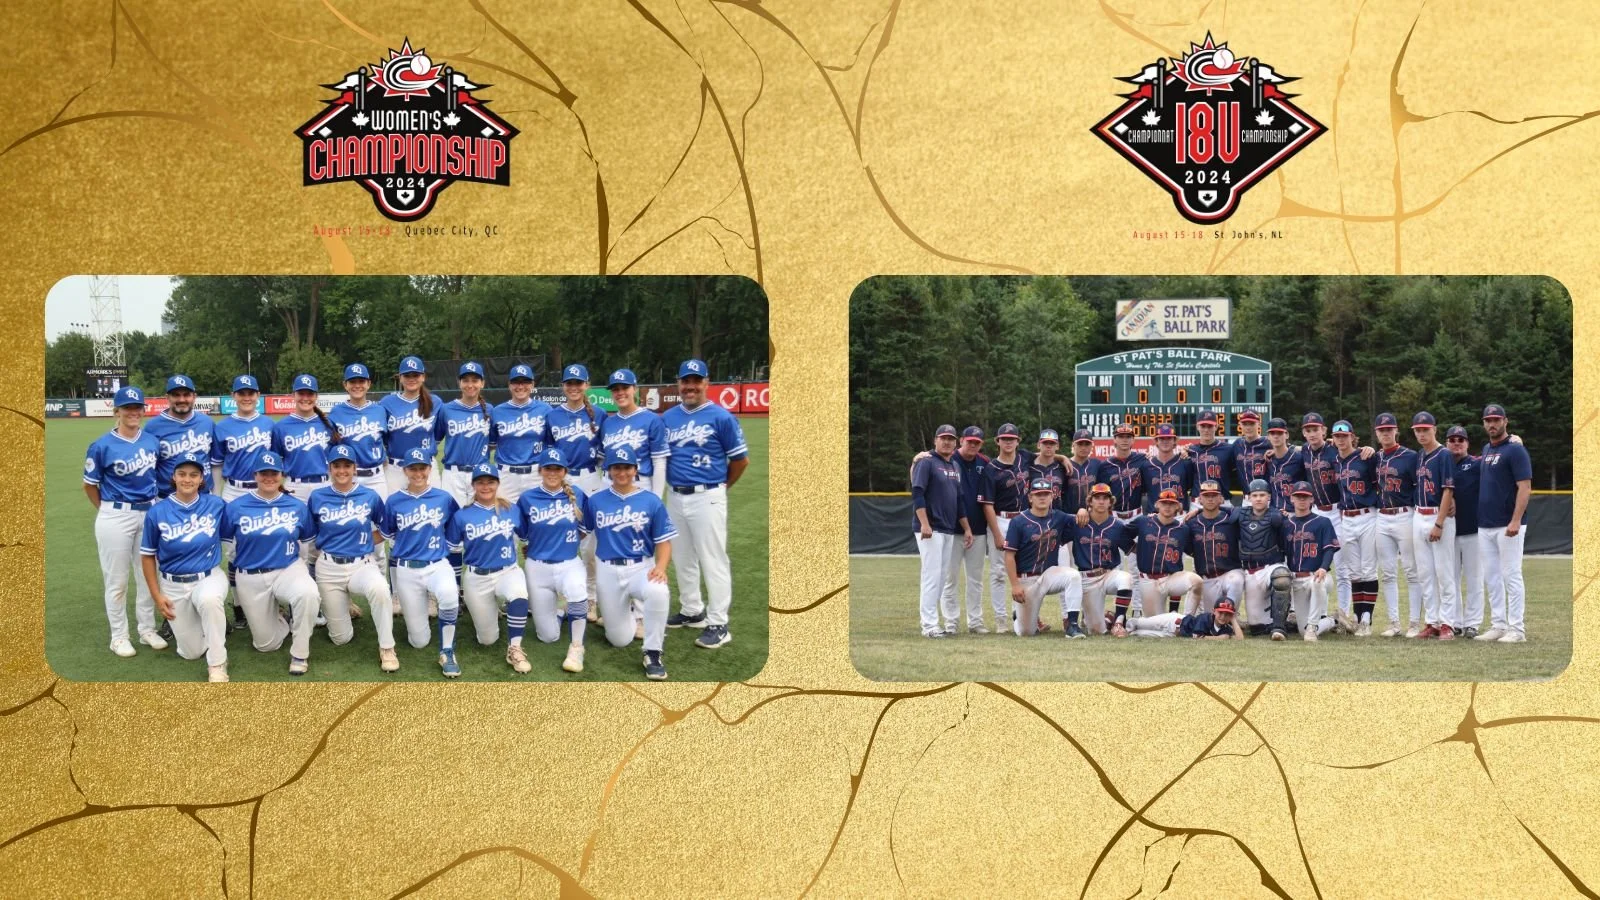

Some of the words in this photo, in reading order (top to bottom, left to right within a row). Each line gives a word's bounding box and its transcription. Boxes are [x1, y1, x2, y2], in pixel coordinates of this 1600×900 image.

[1164, 305, 1180, 318] ST.
[1182, 305, 1212, 318] PAT'S
[1164, 321, 1193, 333] BALL
[1196, 320, 1227, 332] PARK
[1114, 354, 1129, 364] ST
[1131, 350, 1163, 361] PAT'S
[1167, 349, 1197, 359] BALL
[1200, 351, 1232, 363] PARK
[1087, 375, 1096, 387] AT
[1099, 375, 1112, 387] BAT
[1133, 375, 1152, 387] BALL
[1167, 374, 1196, 387] STRIKE
[1208, 374, 1225, 387] OUT
[1258, 374, 1263, 386] E
[1139, 389, 1148, 404] 0
[1177, 389, 1186, 404] 0
[1212, 389, 1221, 404] 0
[497, 413, 546, 437] Québec
[1081, 413, 1120, 426] GUESTS
[159, 429, 213, 459] Québec
[226, 426, 272, 453] Québec
[284, 427, 331, 453] Québec
[691, 454, 712, 468] 34
[318, 499, 372, 525] Québec
[396, 504, 444, 531] Québec
[595, 505, 650, 532] Québec
[157, 513, 217, 542] Québec
[239, 507, 299, 535] Québec
[465, 515, 516, 540] Québec
